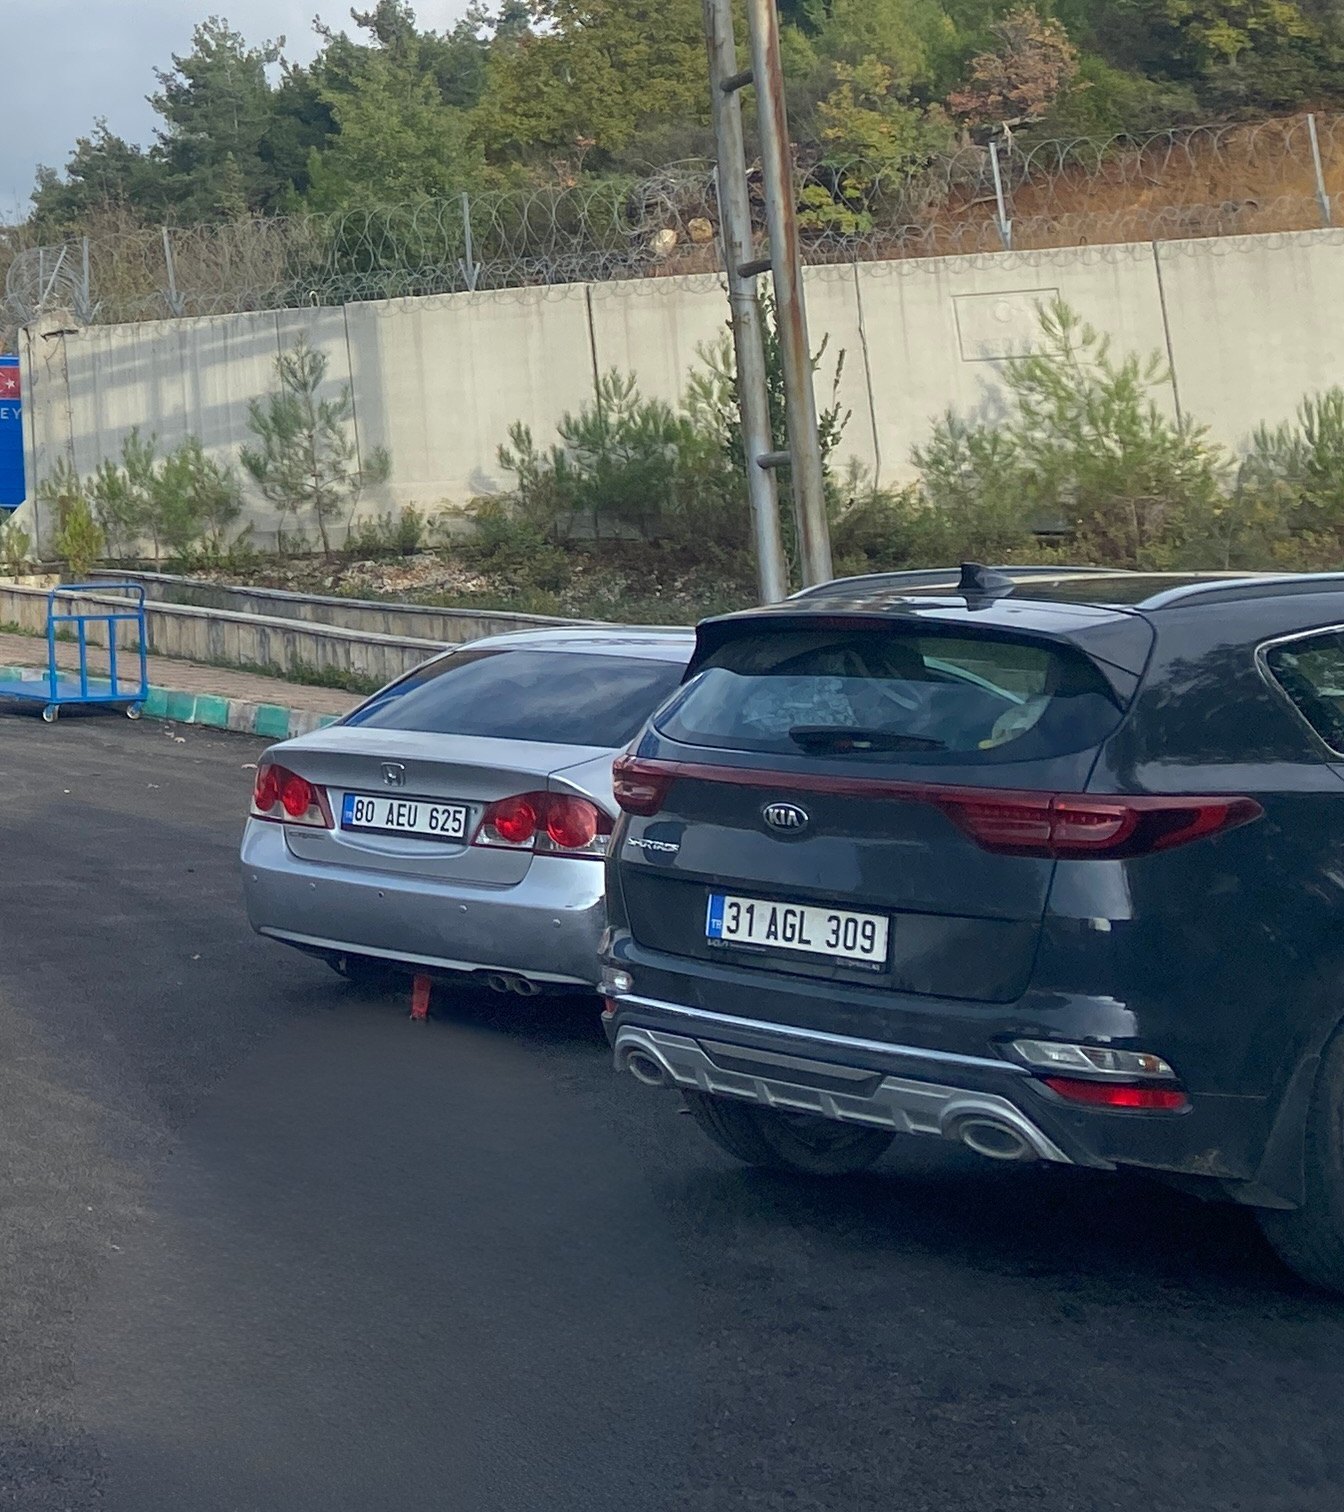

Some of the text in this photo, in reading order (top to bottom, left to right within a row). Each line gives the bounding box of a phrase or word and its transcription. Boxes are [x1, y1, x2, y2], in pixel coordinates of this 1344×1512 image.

[354, 799, 463, 833] 80 AEU 625
[768, 808, 800, 827] KIA
[726, 902, 877, 954] 31 AGL 309
